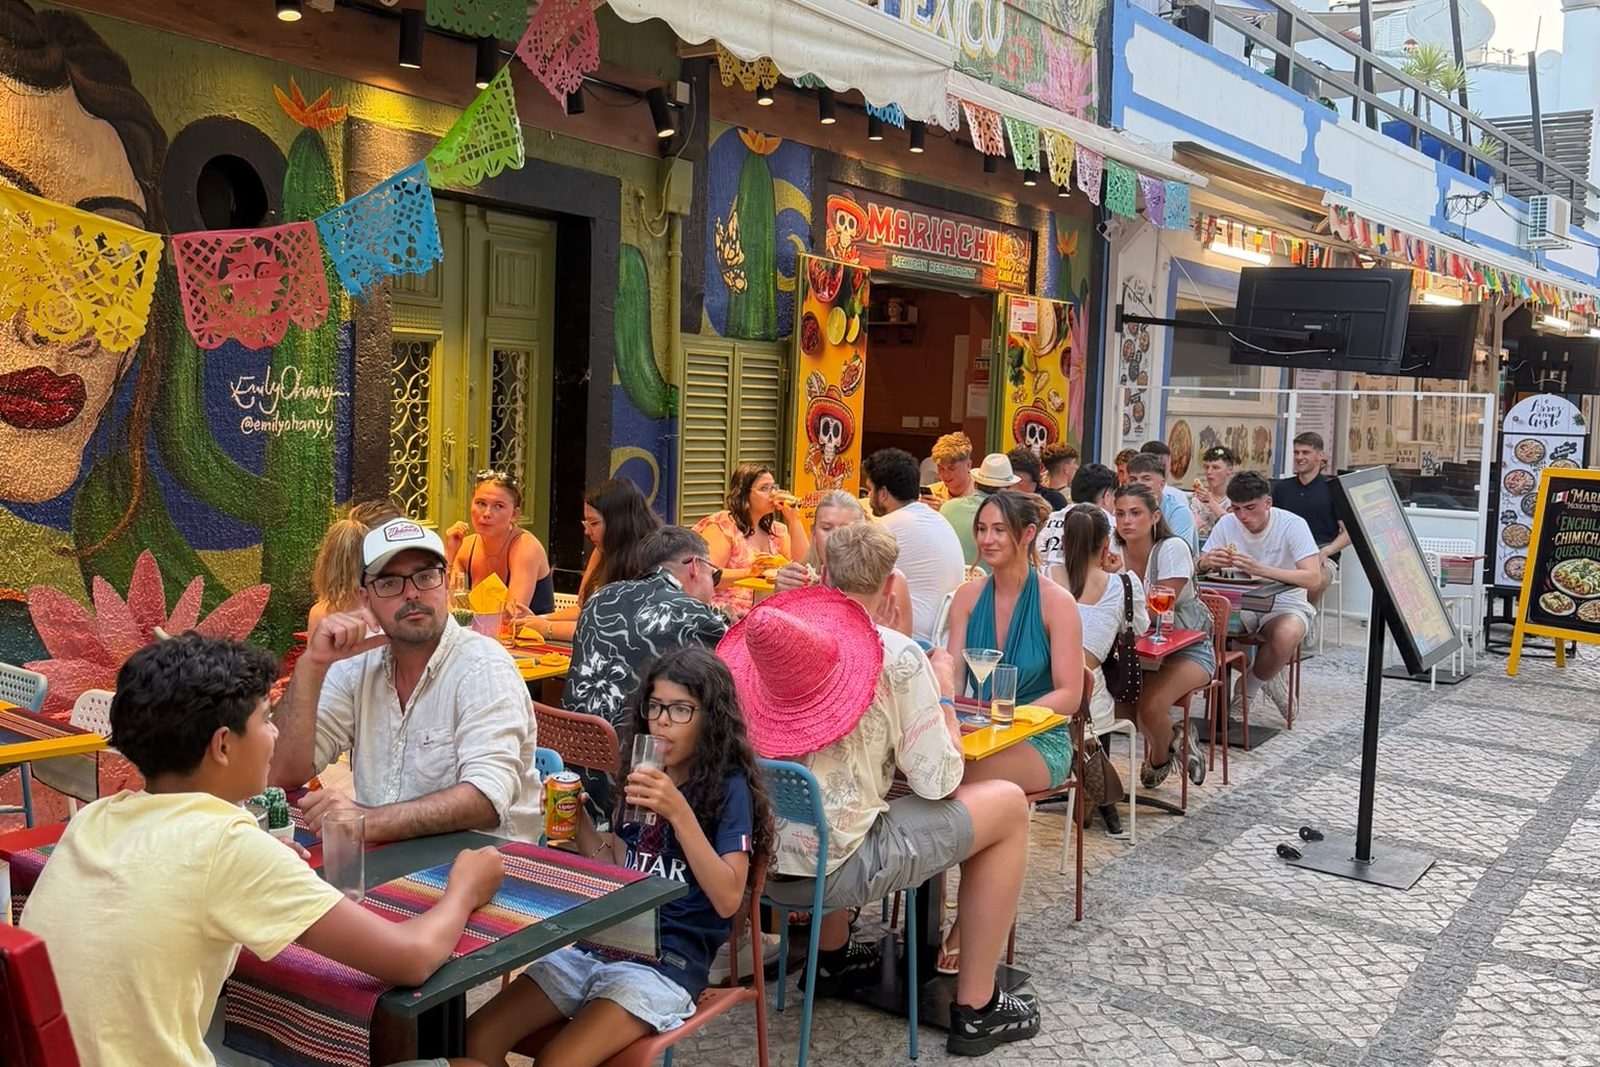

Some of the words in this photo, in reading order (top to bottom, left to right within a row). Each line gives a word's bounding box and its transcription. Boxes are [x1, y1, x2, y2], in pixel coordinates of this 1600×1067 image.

[866, 203, 999, 265] MARIACHI
[892, 254, 928, 272] MEXICAN
[929, 261, 977, 279] RESTAURANT
[241, 410, 333, 439] @emilyohanyy
[1559, 515, 1600, 531] ENCHIL
[1554, 531, 1600, 546] CHIMICH
